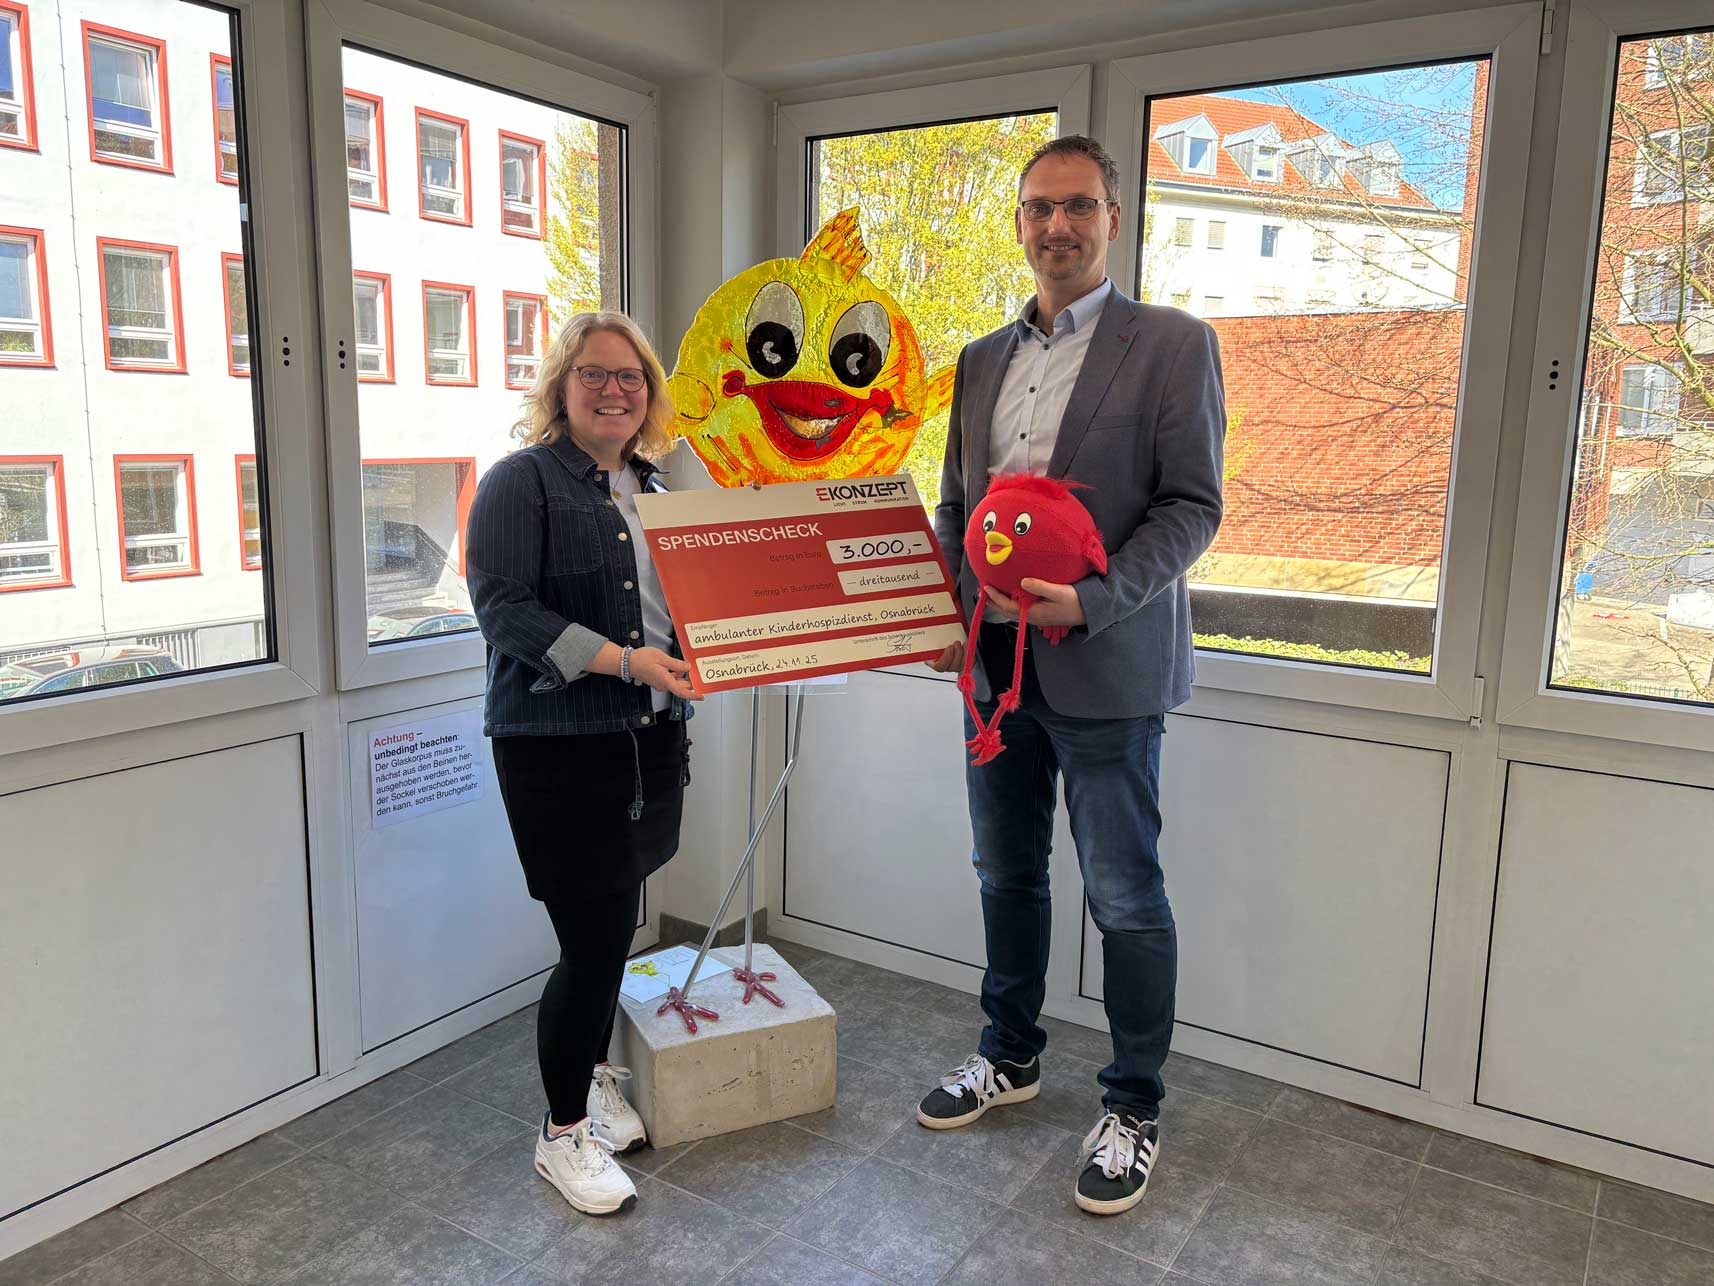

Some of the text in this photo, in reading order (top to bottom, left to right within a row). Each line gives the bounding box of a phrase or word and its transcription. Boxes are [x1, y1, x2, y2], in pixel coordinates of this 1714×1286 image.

[815, 481, 907, 502] EKONZEPT
[658, 522, 823, 551] SPENDENSCHECK
[769, 552, 795, 562] Betrag
[804, 551, 822, 559] Euro
[859, 570, 921, 587] dreitausend
[694, 604, 936, 644] ambulanter Kinderhospizdienst, Osnabrück
[705, 661, 775, 680] Osnabrück,
[373, 732, 415, 748] Achtung
[374, 743, 418, 760] unbedingt
[375, 744, 466, 772] Der Glaskorpus muss zu-
[375, 752, 473, 783] nächst aus den Beinen her-
[376, 762, 473, 795] ausgehoben werden, bevor
[376, 772, 475, 805] der Sockel verschoben wer-
[376, 782, 480, 816] den kann, sonst Bruchgefahr.
